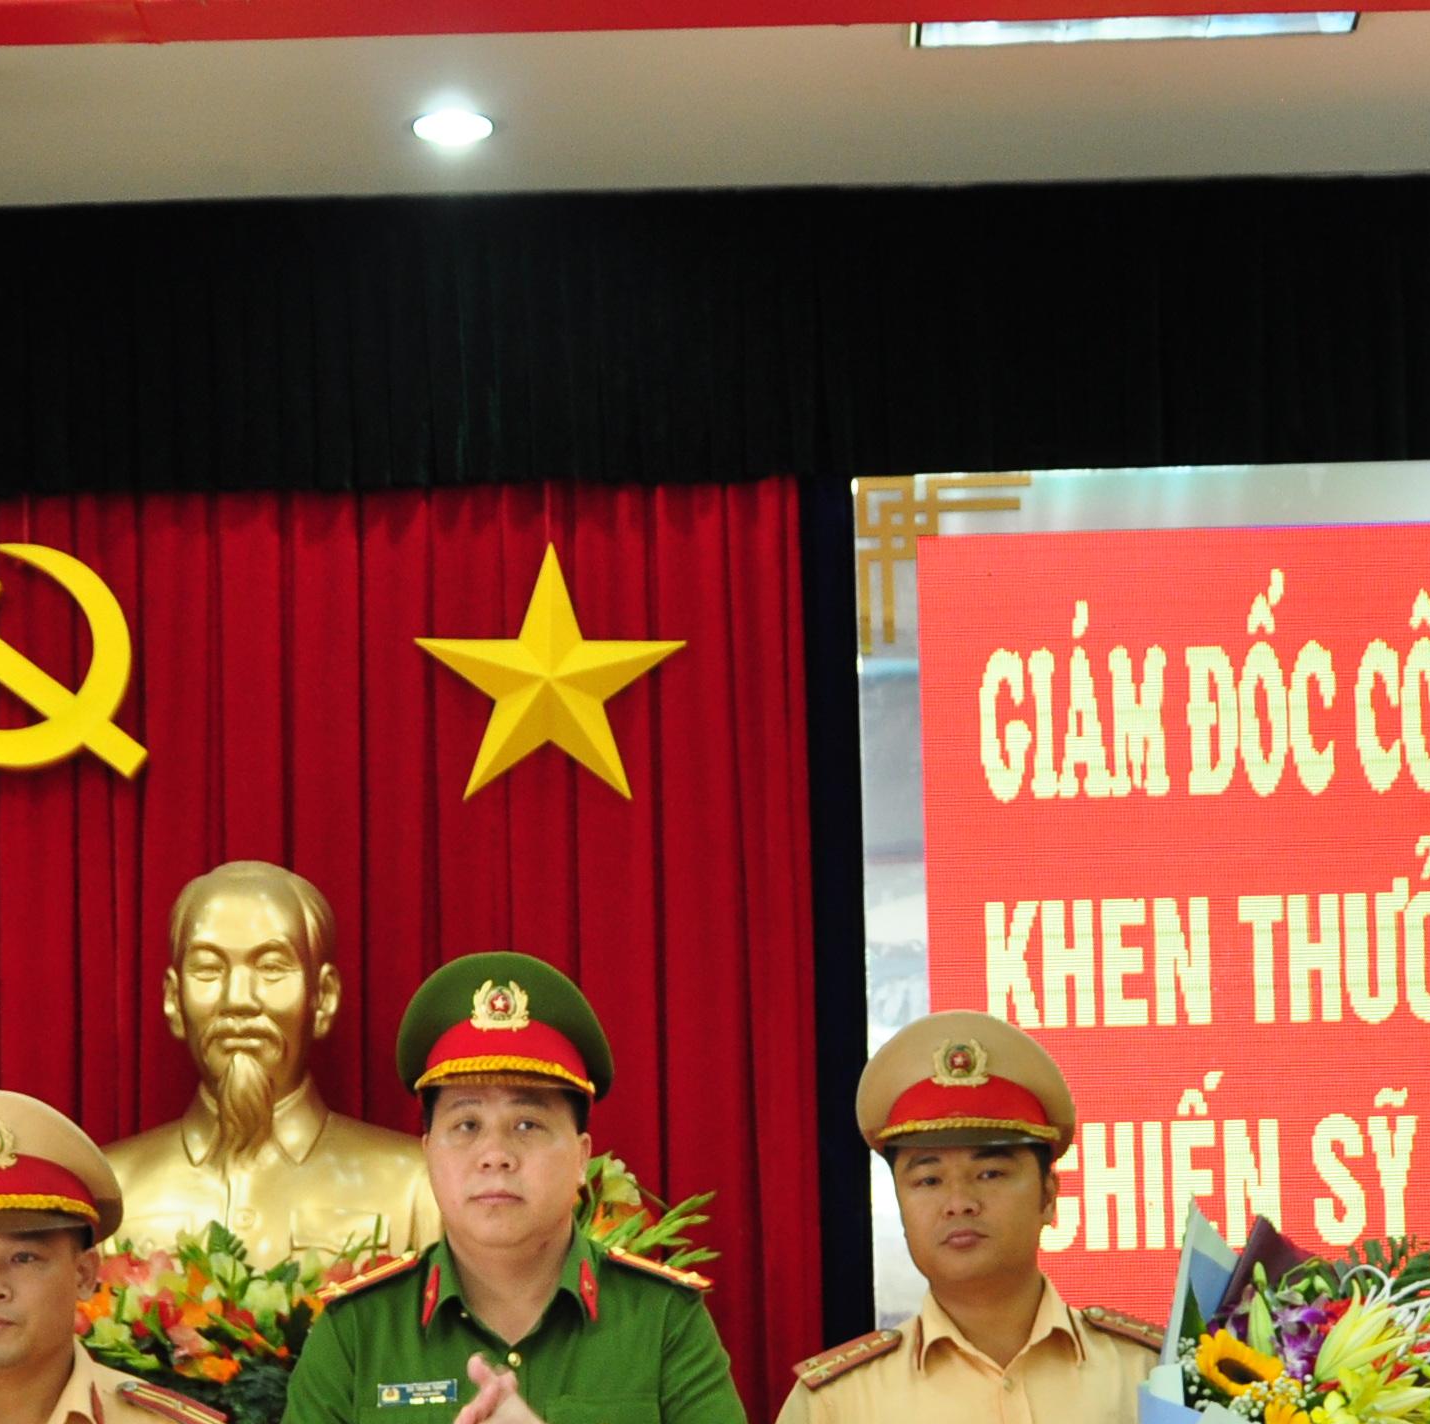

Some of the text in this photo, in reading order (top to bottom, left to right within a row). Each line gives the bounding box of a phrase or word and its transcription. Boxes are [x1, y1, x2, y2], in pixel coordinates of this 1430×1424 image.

[979, 600, 1170, 803] GIÁM
[1185, 568, 1336, 797] ĐỐC
[984, 897, 1212, 1029] KHEN
[1311, 1087, 1419, 1247] SỸ
